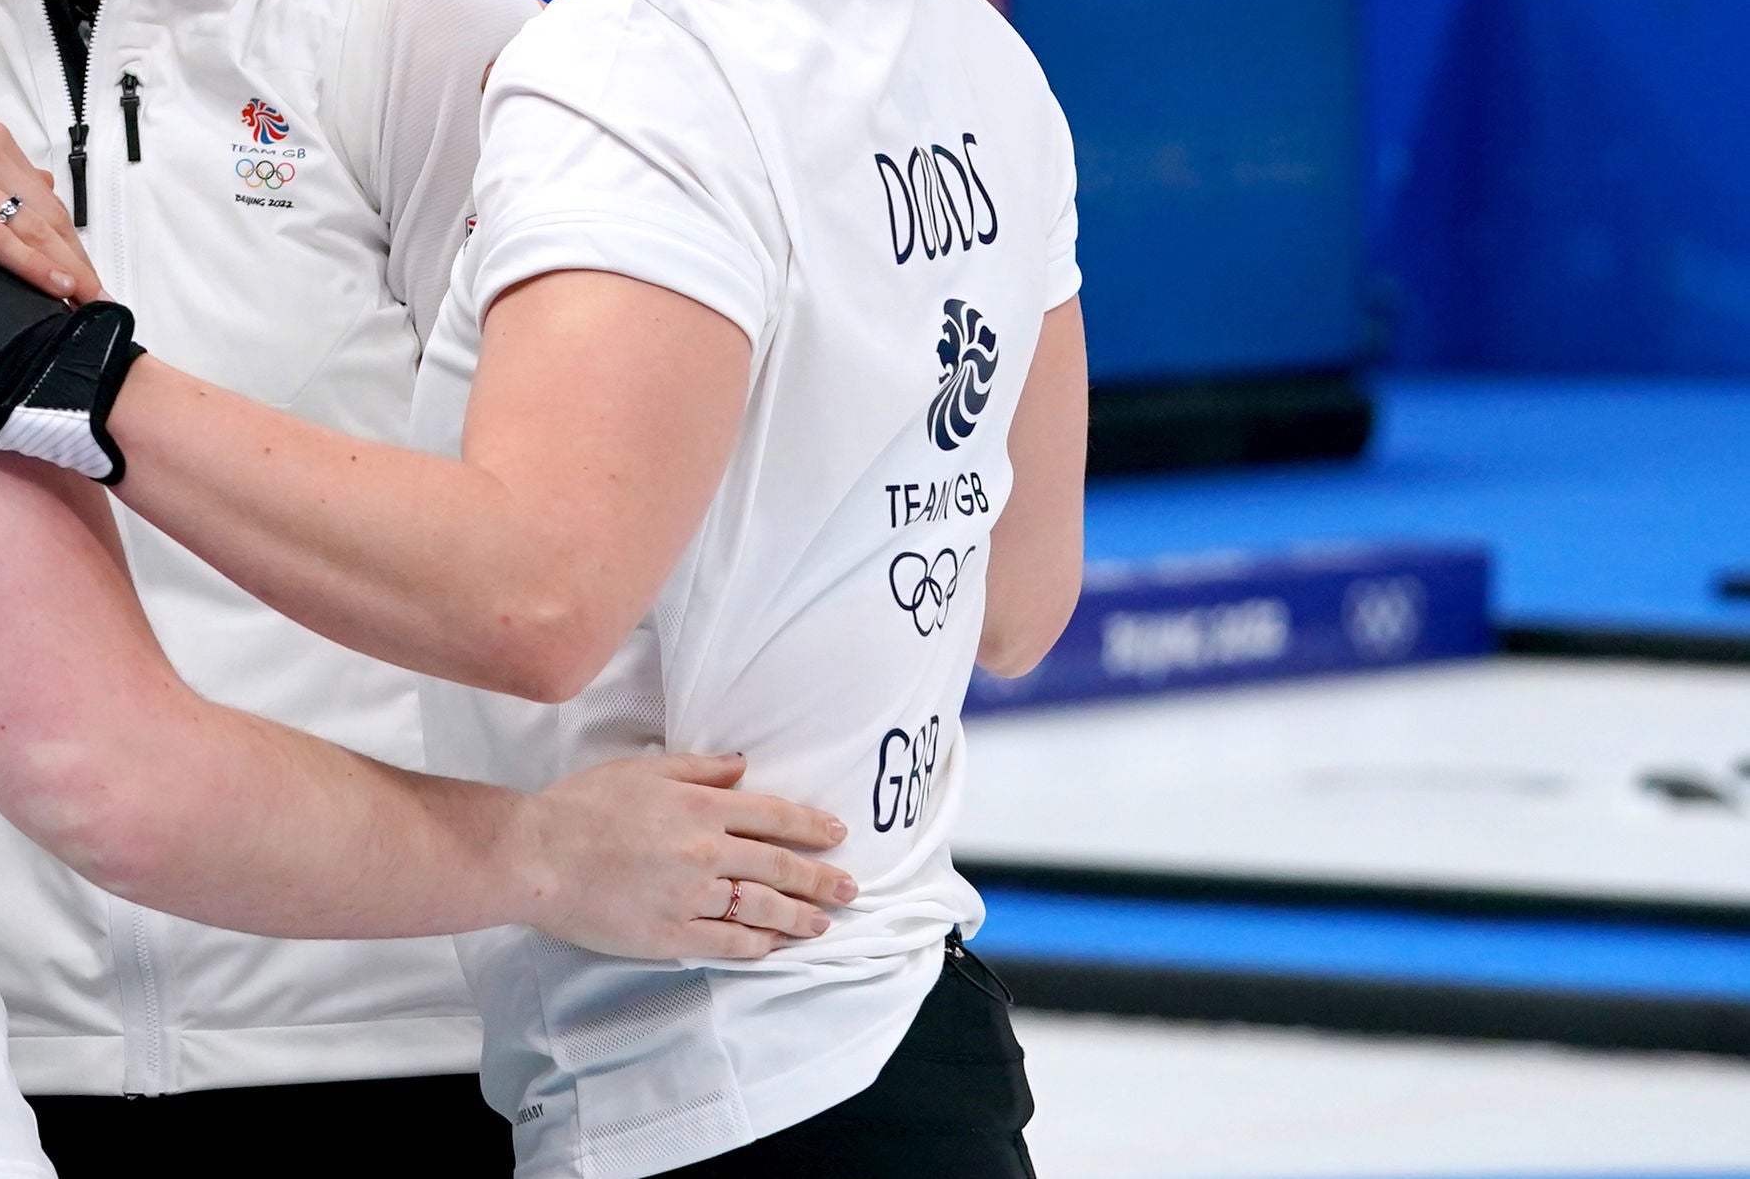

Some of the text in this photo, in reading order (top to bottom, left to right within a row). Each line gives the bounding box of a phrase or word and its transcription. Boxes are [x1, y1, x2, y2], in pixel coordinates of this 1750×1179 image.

[231, 144, 306, 159] TEAM GB
[235, 193, 294, 209] BEIJING 2022
[874, 132, 998, 265] DODDS
[885, 472, 989, 528] TEAM GB
[872, 714, 939, 833] GBR
